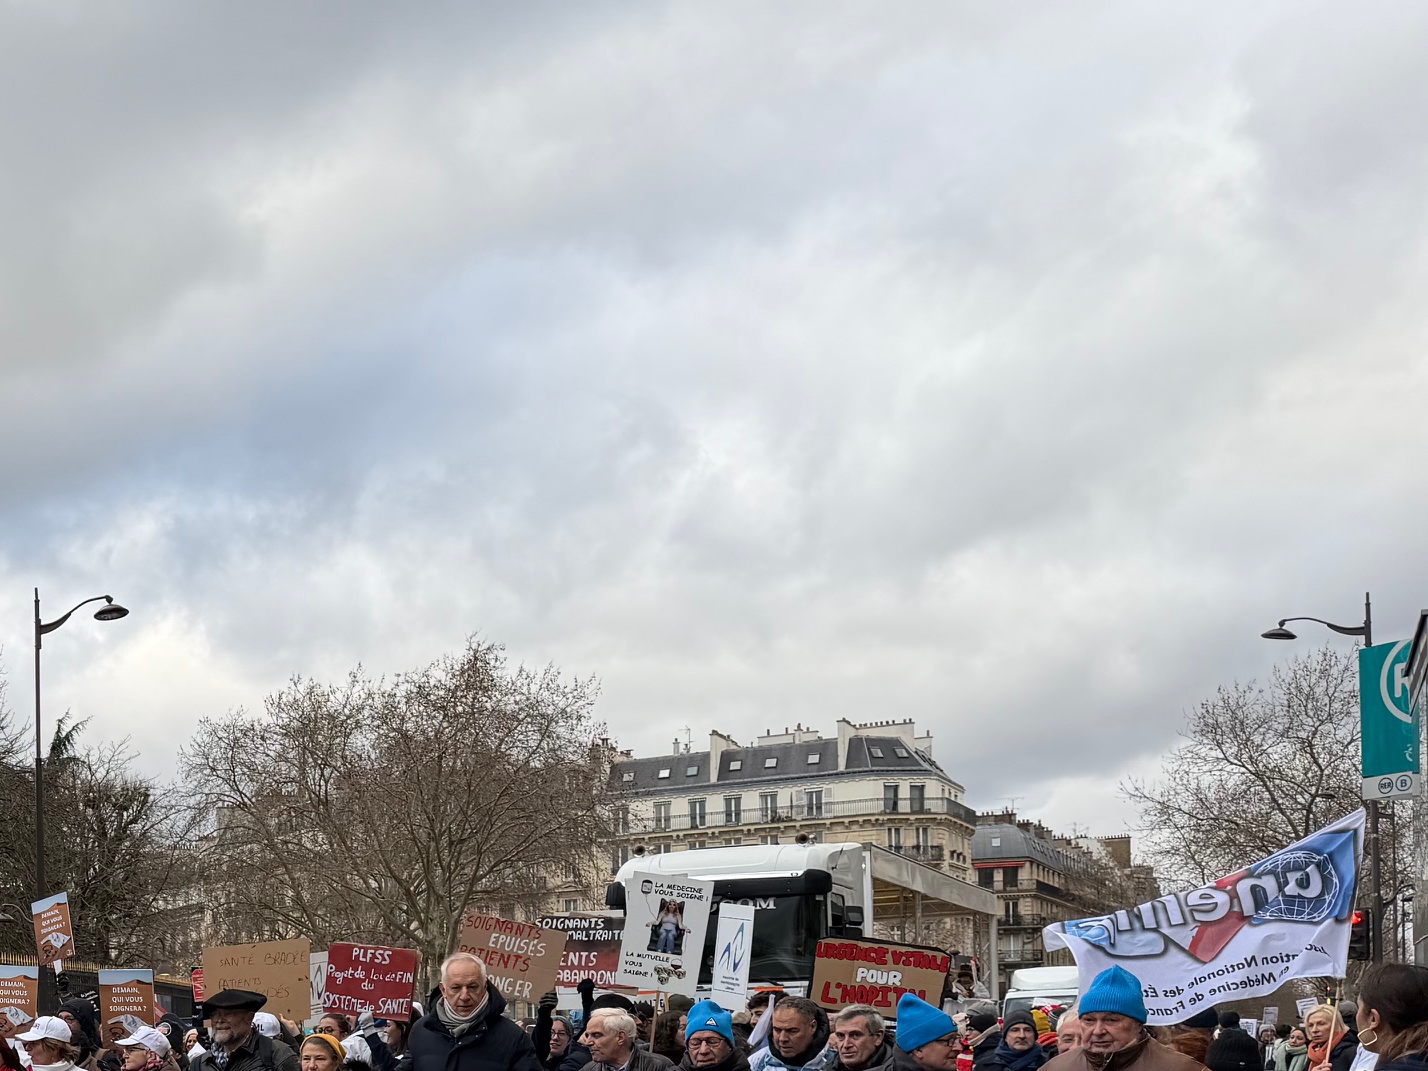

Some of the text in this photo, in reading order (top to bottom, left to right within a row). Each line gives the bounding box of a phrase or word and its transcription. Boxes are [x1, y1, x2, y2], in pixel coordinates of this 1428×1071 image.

[1400, 779, 1407, 788] B
[654, 888, 674, 897] VOUS
[676, 891, 704, 902] SOIGNE
[667, 883, 704, 894] MEDECINE
[466, 915, 544, 940] SOIGNANTS
[535, 918, 605, 929] SOIGNANTS
[219, 950, 307, 967] SANTÉ BRADÉE
[352, 947, 392, 964] PLFSS
[638, 953, 670, 963] MUTUELLE
[816, 940, 950, 973] URGENCE VITALE
[354, 966, 366, 978] de
[371, 968, 383, 980] loi
[385, 972, 395, 981] de
[396, 972, 414, 983] FIN
[623, 969, 649, 977] SAIGNE
[856, 967, 903, 986] POUR
[218, 977, 262, 990] PATIENTS
[361, 979, 375, 990] du
[323, 992, 412, 1015] SYSTEME de SANTÉ
